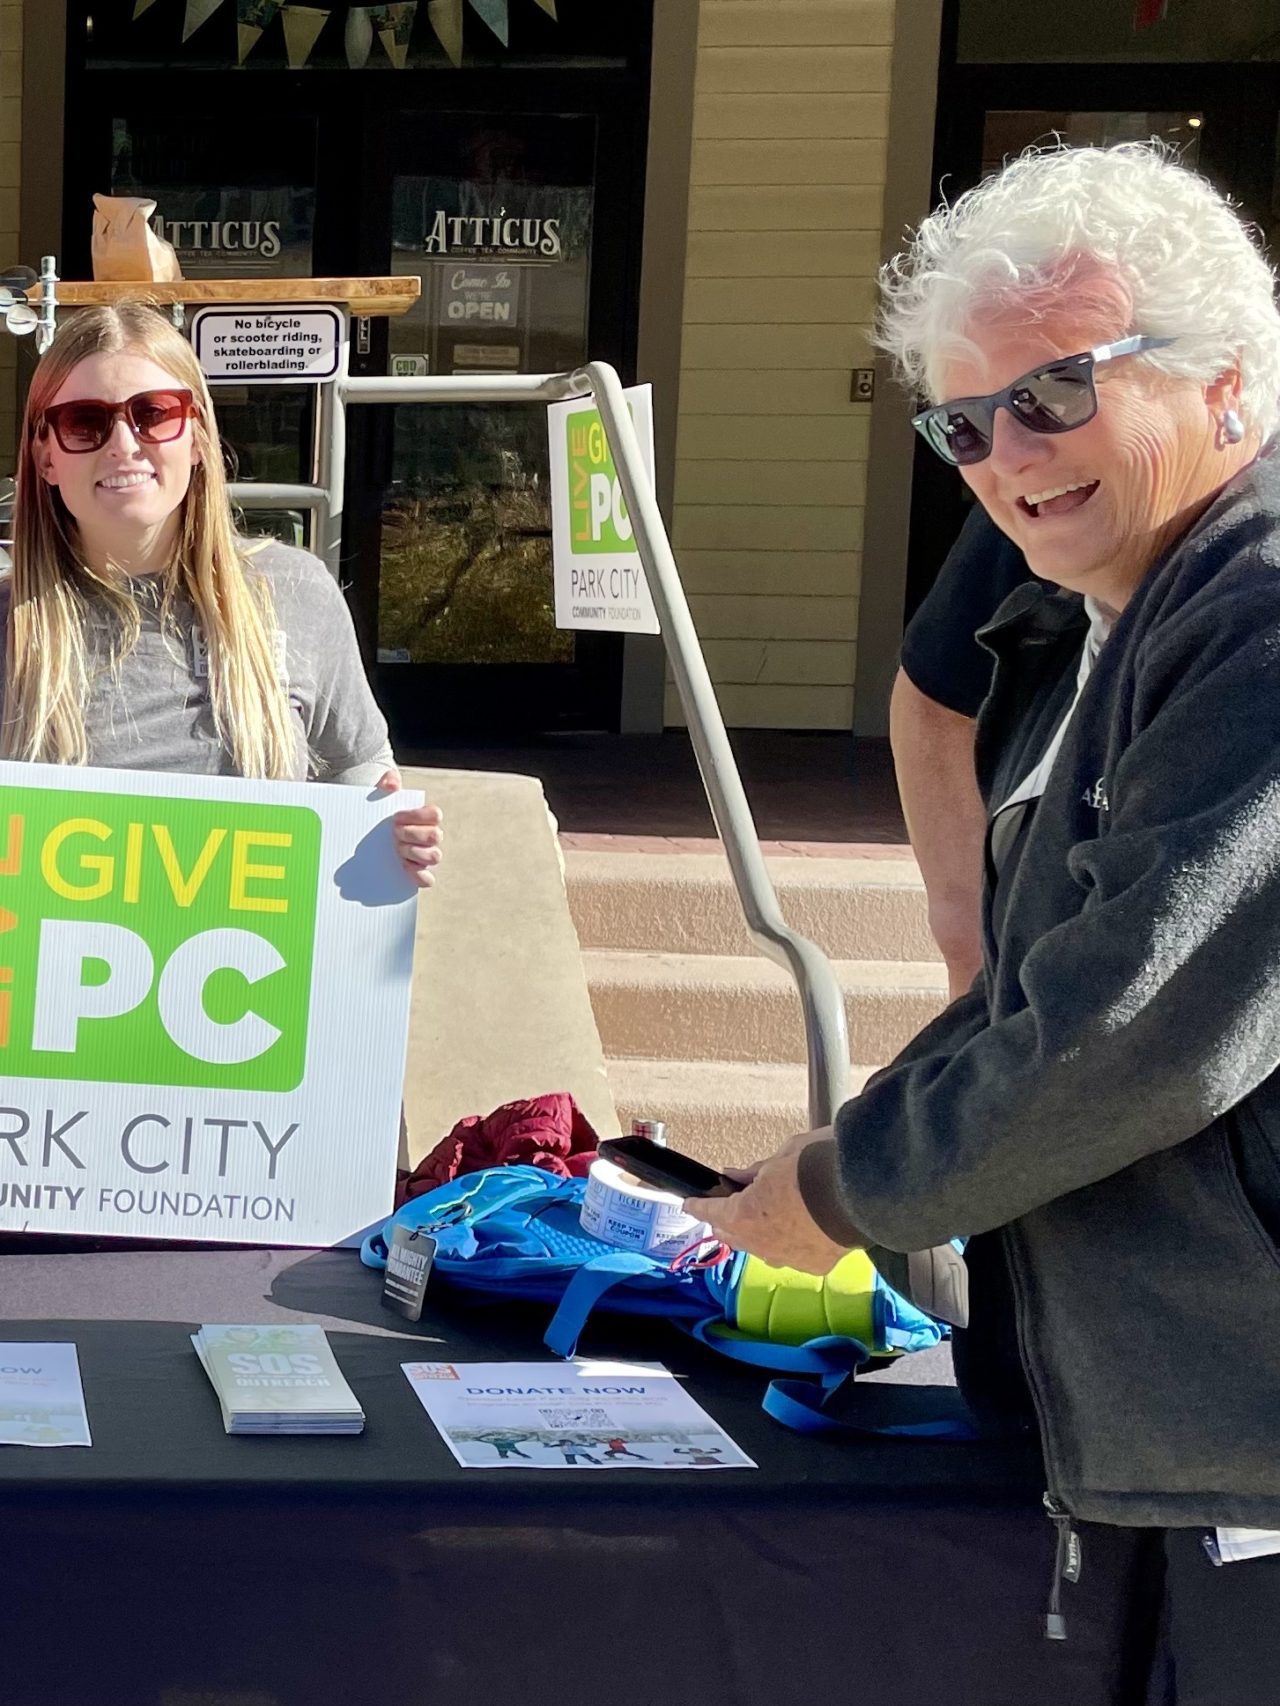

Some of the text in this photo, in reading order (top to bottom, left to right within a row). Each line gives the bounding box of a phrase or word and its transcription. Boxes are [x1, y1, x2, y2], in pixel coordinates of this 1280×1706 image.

[425, 211, 561, 255] ATTICUS
[447, 301, 510, 320] OPEN
[235, 318, 301, 330] No bicycle
[230, 333, 278, 343] scooter
[282, 332, 322, 344] riding,
[214, 346, 321, 357] skateboarding or
[225, 360, 308, 370] rollerblading.
[572, 424, 590, 541] LIVE
[572, 568, 639, 599] PARK CITY
[40, 817, 293, 913] GIVE
[32, 918, 287, 1064] PC
[121, 1113, 300, 1179] CITY
[99, 1188, 296, 1221] FOUNDATION
[618, 1193, 646, 1209] TICKET
[227, 1353, 324, 1374] SOS
[236, 1378, 331, 1387] OUTREACH
[466, 1386, 646, 1395] DONATE NOW
